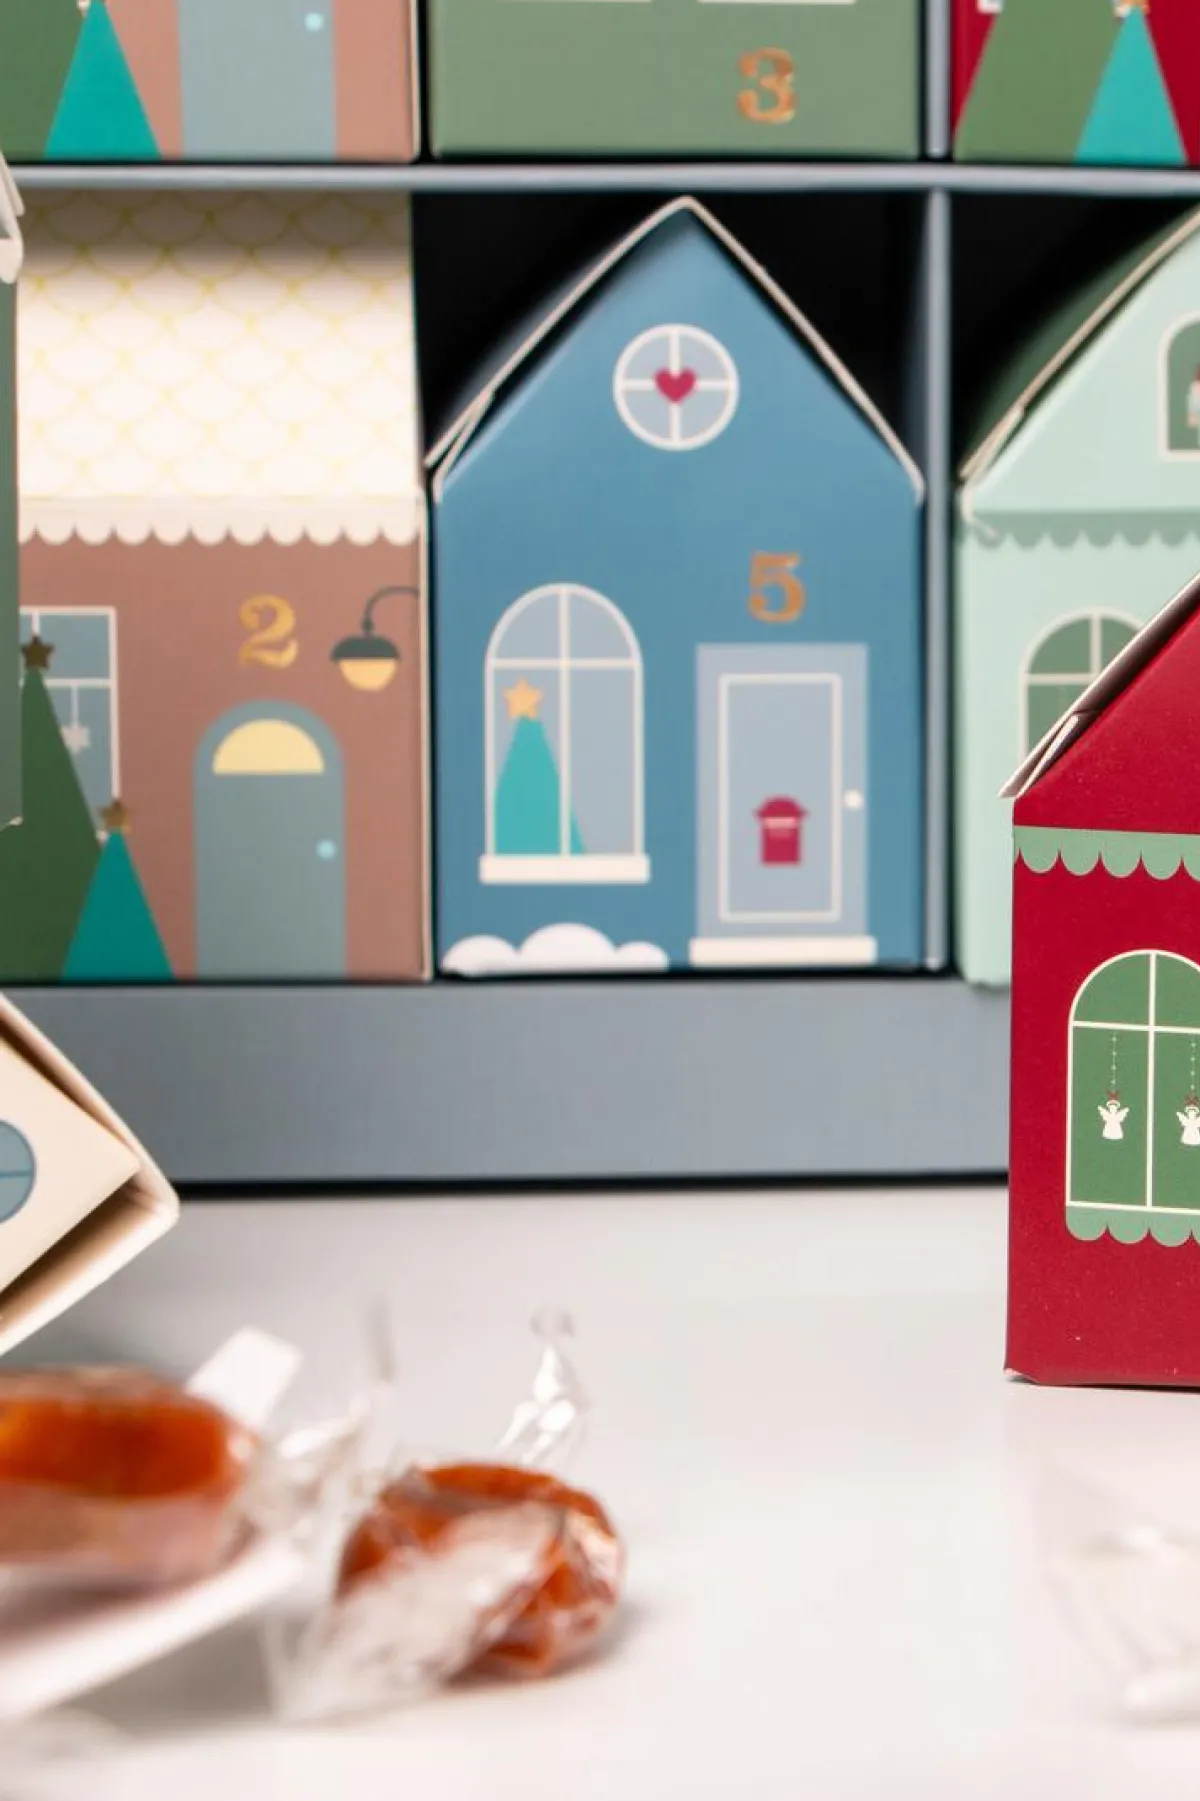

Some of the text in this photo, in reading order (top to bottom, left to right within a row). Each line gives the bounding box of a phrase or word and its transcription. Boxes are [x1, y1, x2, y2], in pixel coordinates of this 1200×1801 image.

[736, 46, 798, 124] 3
[746, 549, 806, 624] 5
[238, 593, 299, 669] 2
